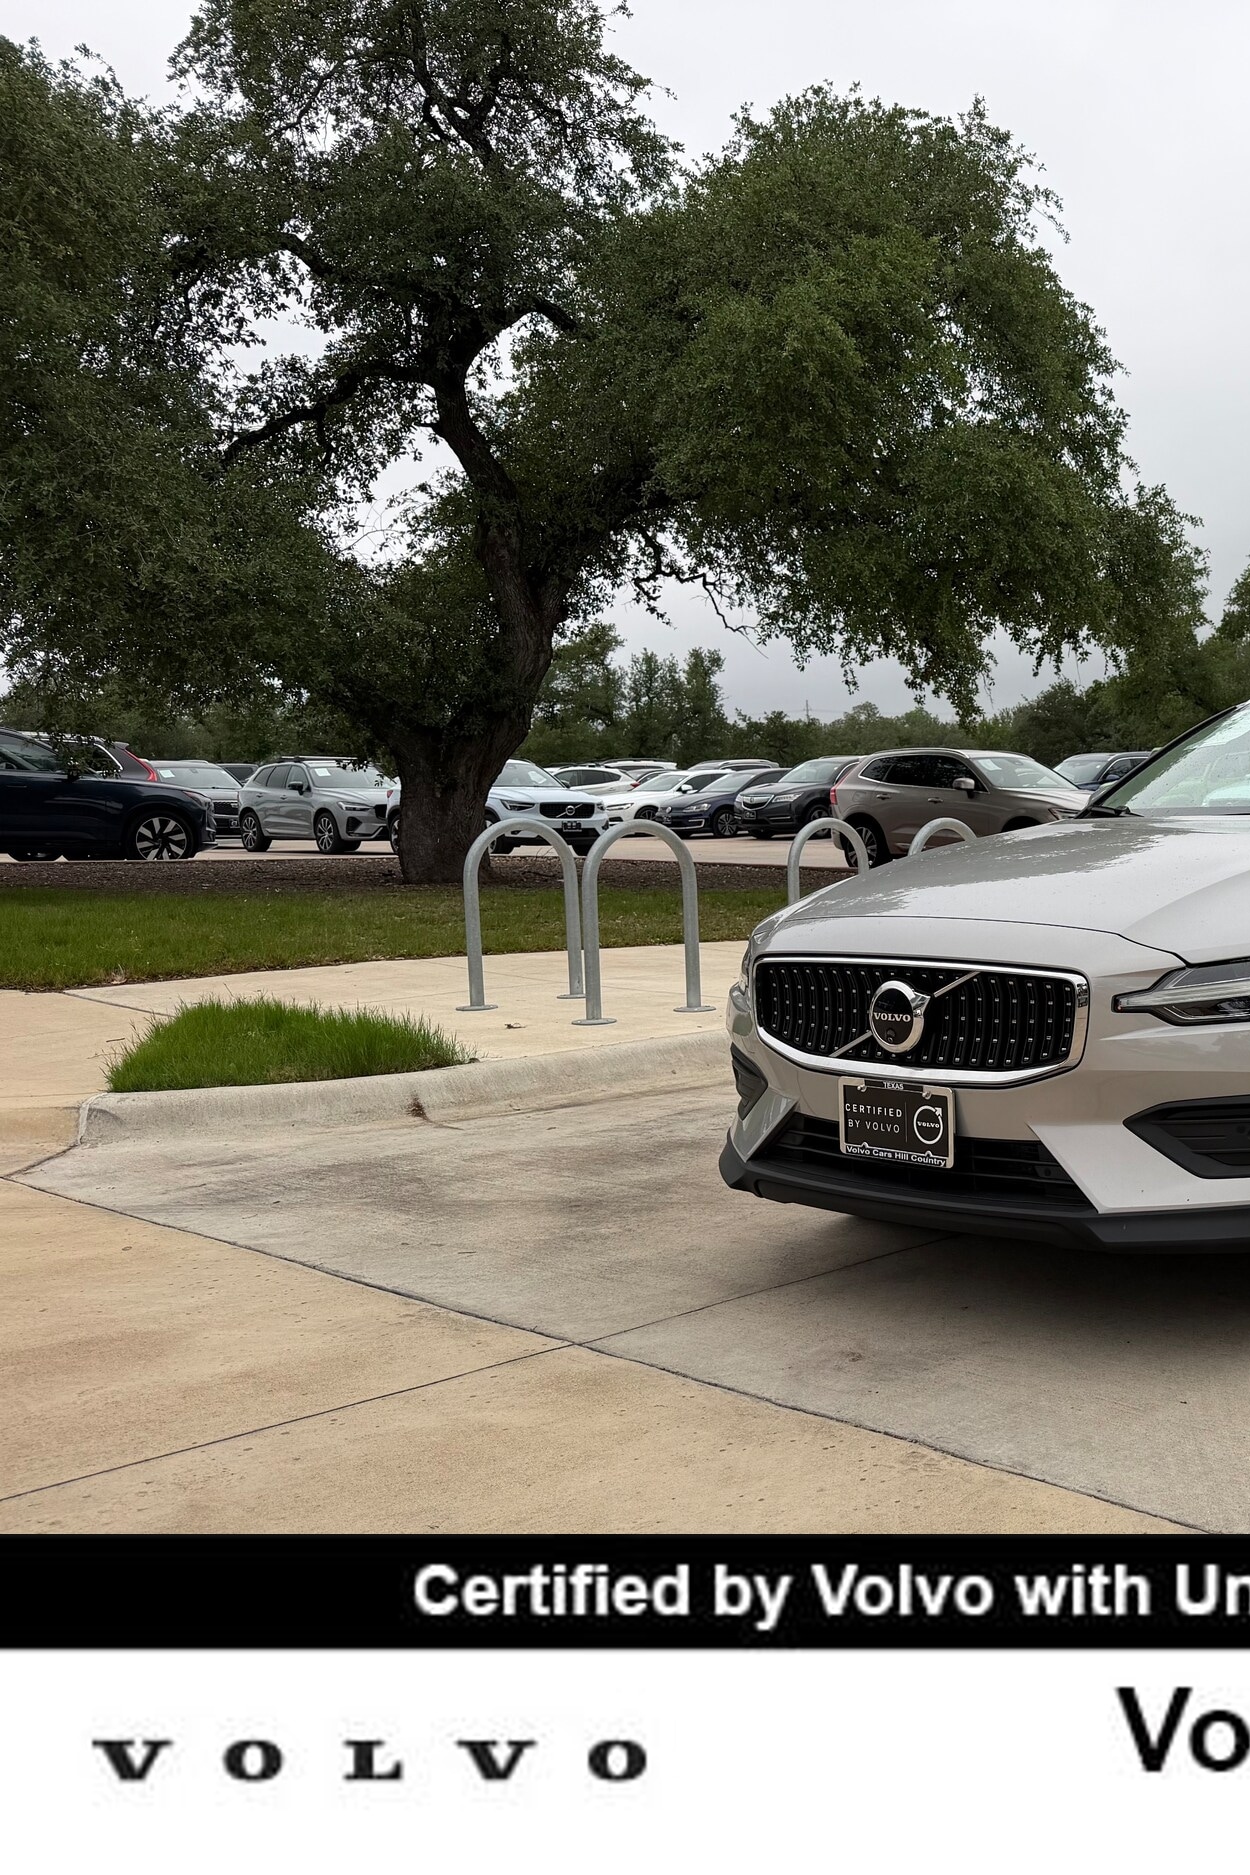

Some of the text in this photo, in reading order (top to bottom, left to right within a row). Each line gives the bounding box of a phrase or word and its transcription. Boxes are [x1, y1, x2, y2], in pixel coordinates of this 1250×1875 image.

[874, 1012, 911, 1022] VOLVO
[883, 1081, 904, 1090] TEXAS
[845, 1103, 903, 1118] CERTIFIED
[848, 1118, 900, 1134] BY VOLVO
[917, 1120, 940, 1129] VOLVO
[846, 1145, 946, 1167] Volvo Cars Hill Country
